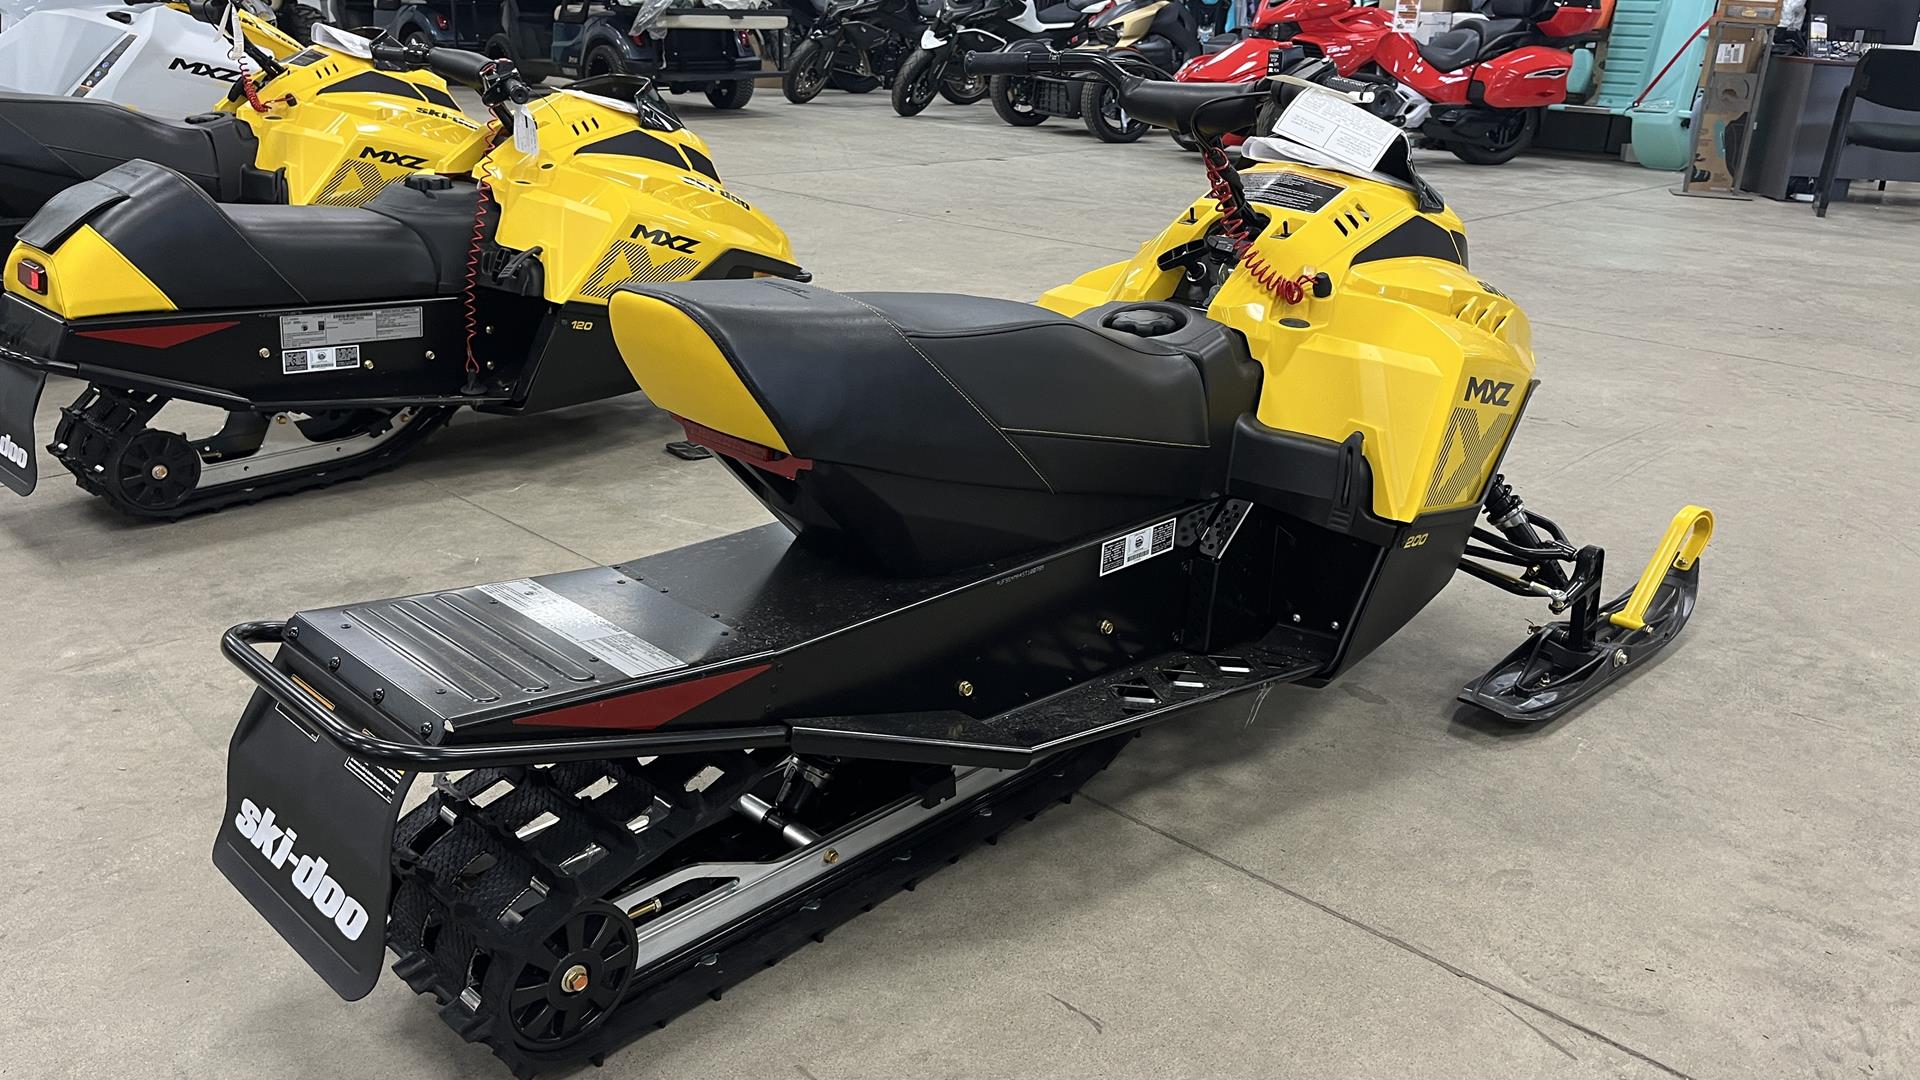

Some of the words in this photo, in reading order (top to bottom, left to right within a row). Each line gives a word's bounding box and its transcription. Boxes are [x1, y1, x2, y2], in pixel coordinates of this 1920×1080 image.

[168, 57, 243, 83] MXZ
[359, 146, 429, 169] MXZ
[630, 223, 701, 254] MXZ
[571, 320, 594, 331] 120
[1464, 376, 1515, 407] MXZ
[1403, 533, 1429, 549] 200
[235, 798, 369, 941] ski-doo
